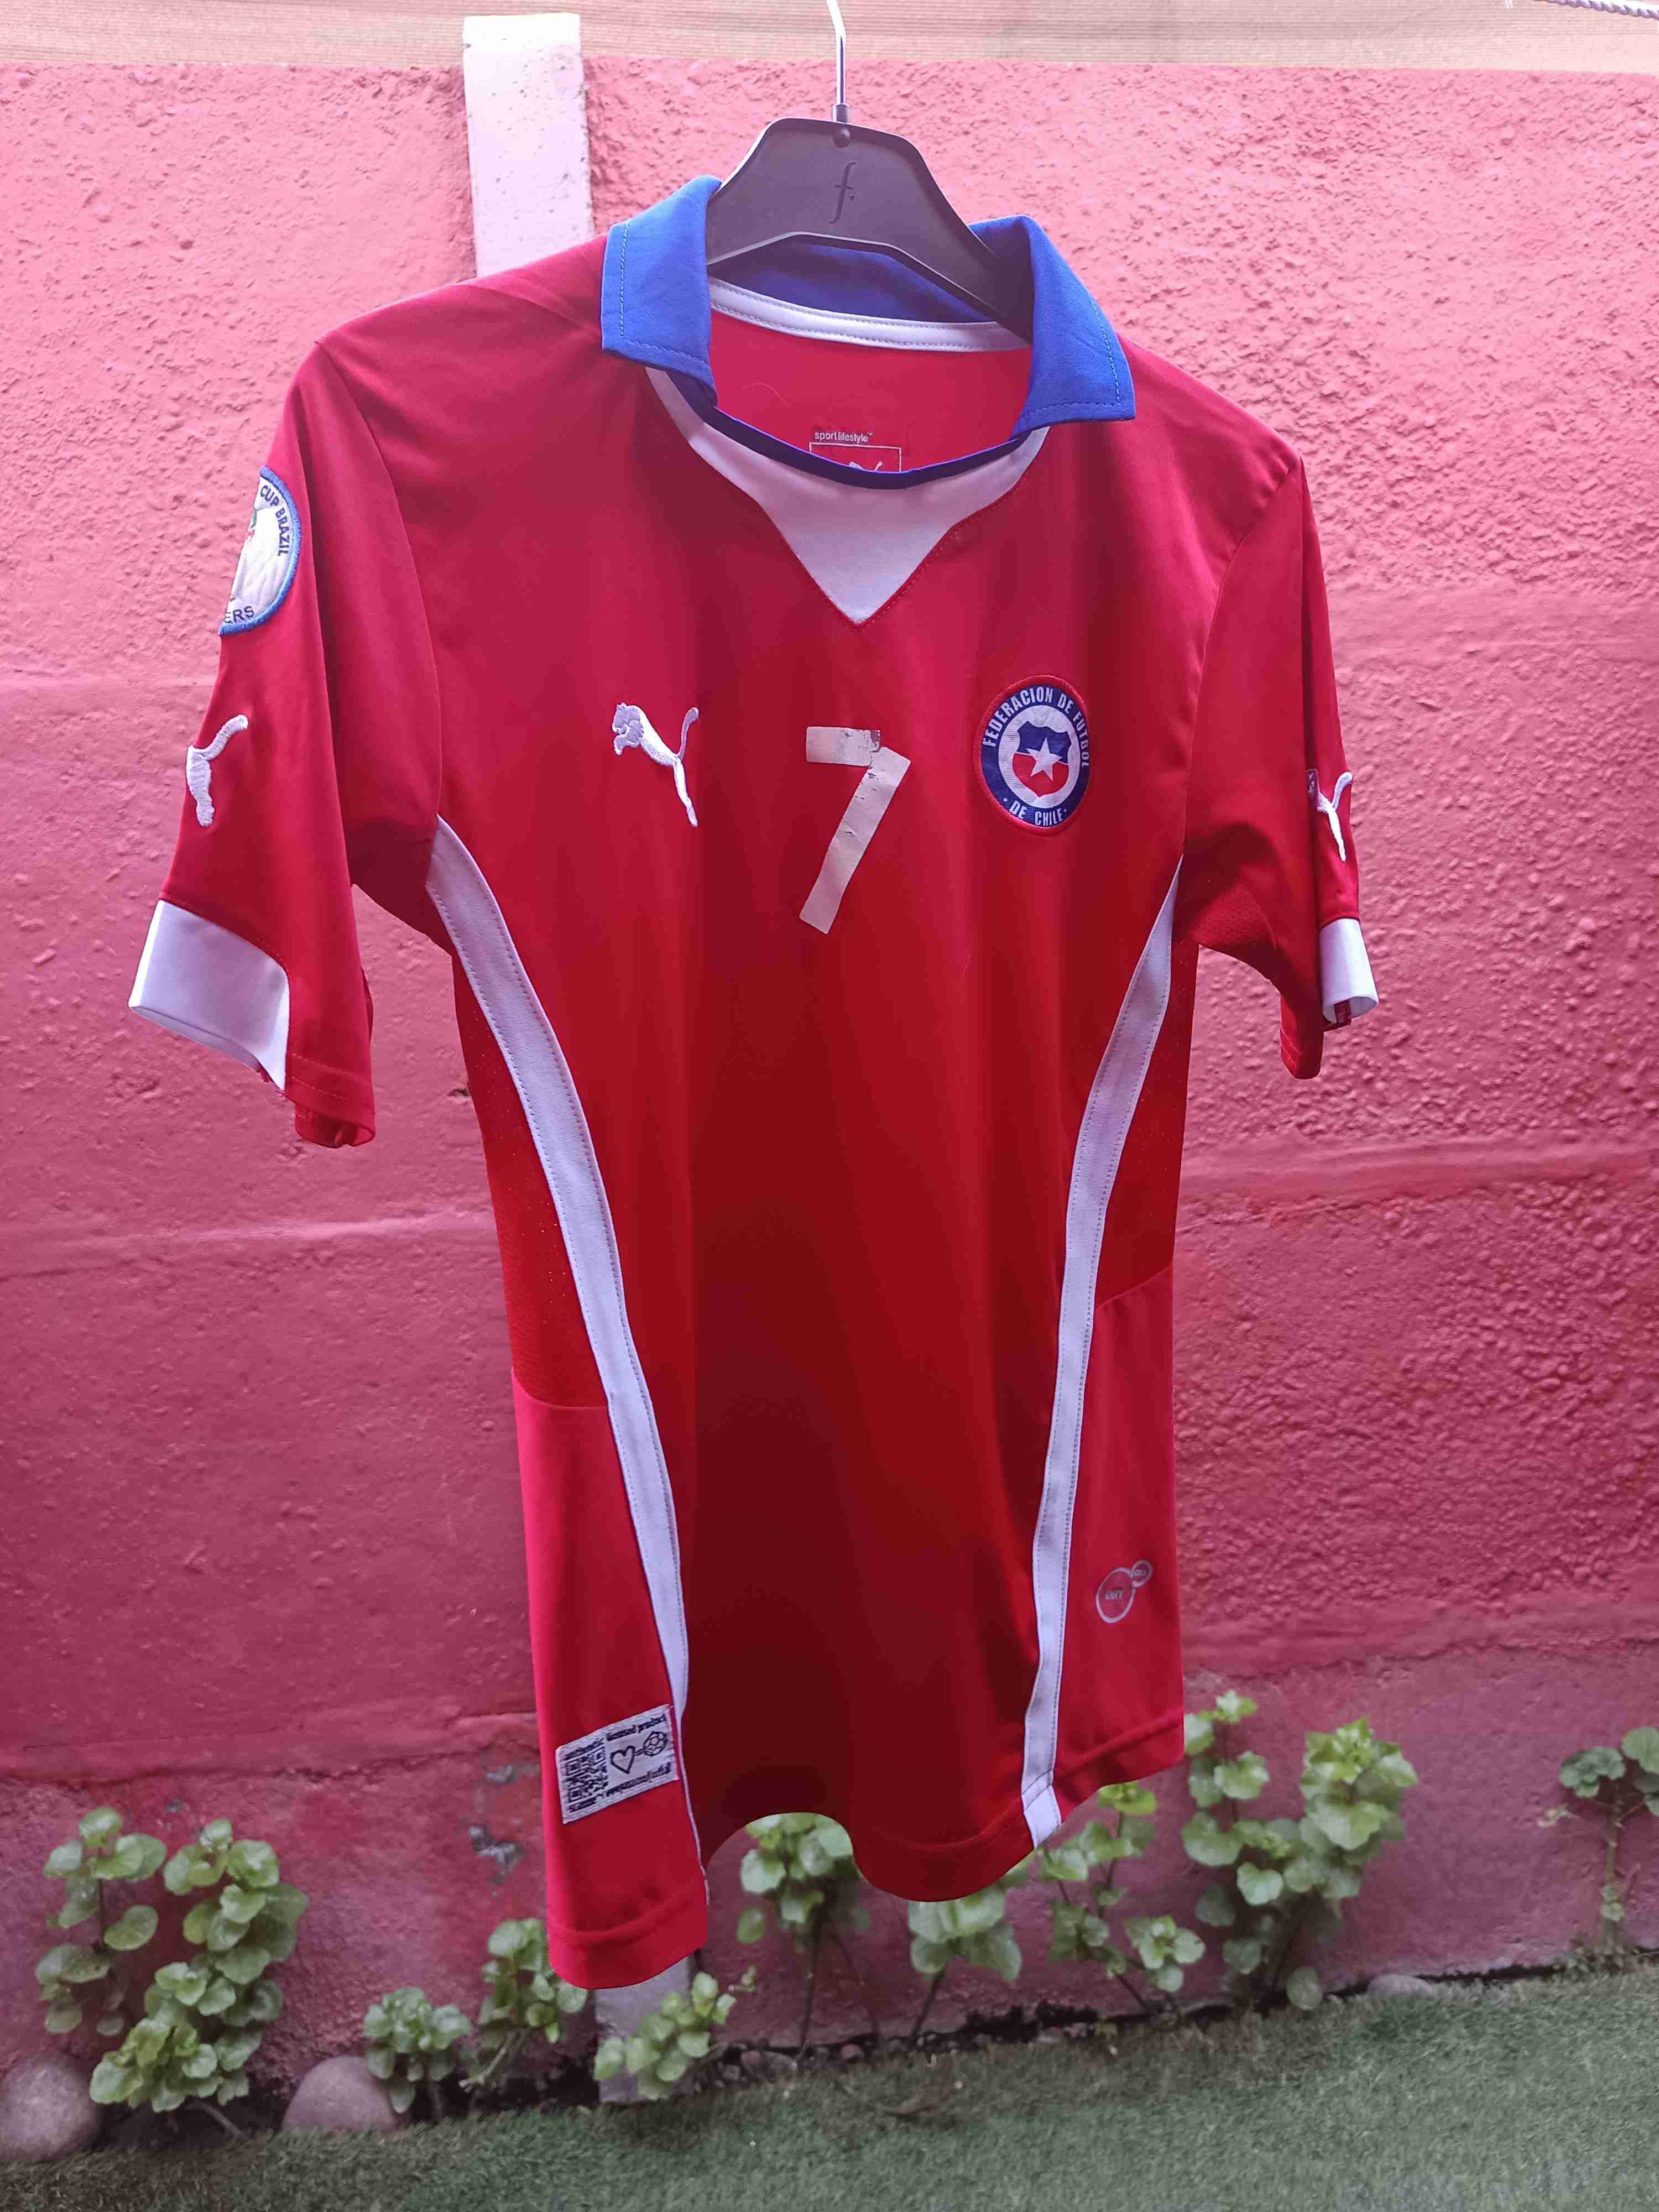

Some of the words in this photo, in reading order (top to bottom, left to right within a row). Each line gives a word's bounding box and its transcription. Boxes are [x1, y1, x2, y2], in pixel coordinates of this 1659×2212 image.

[260, 485, 280, 508] CUP
[275, 507, 290, 557] BRAZIL
[982, 686, 1053, 748] FEDERACION
[1056, 692, 1074, 714] DE
[799, 726, 911, 935] 7
[1009, 800, 1027, 820] DE
[1034, 808, 1063, 827] CHILE
